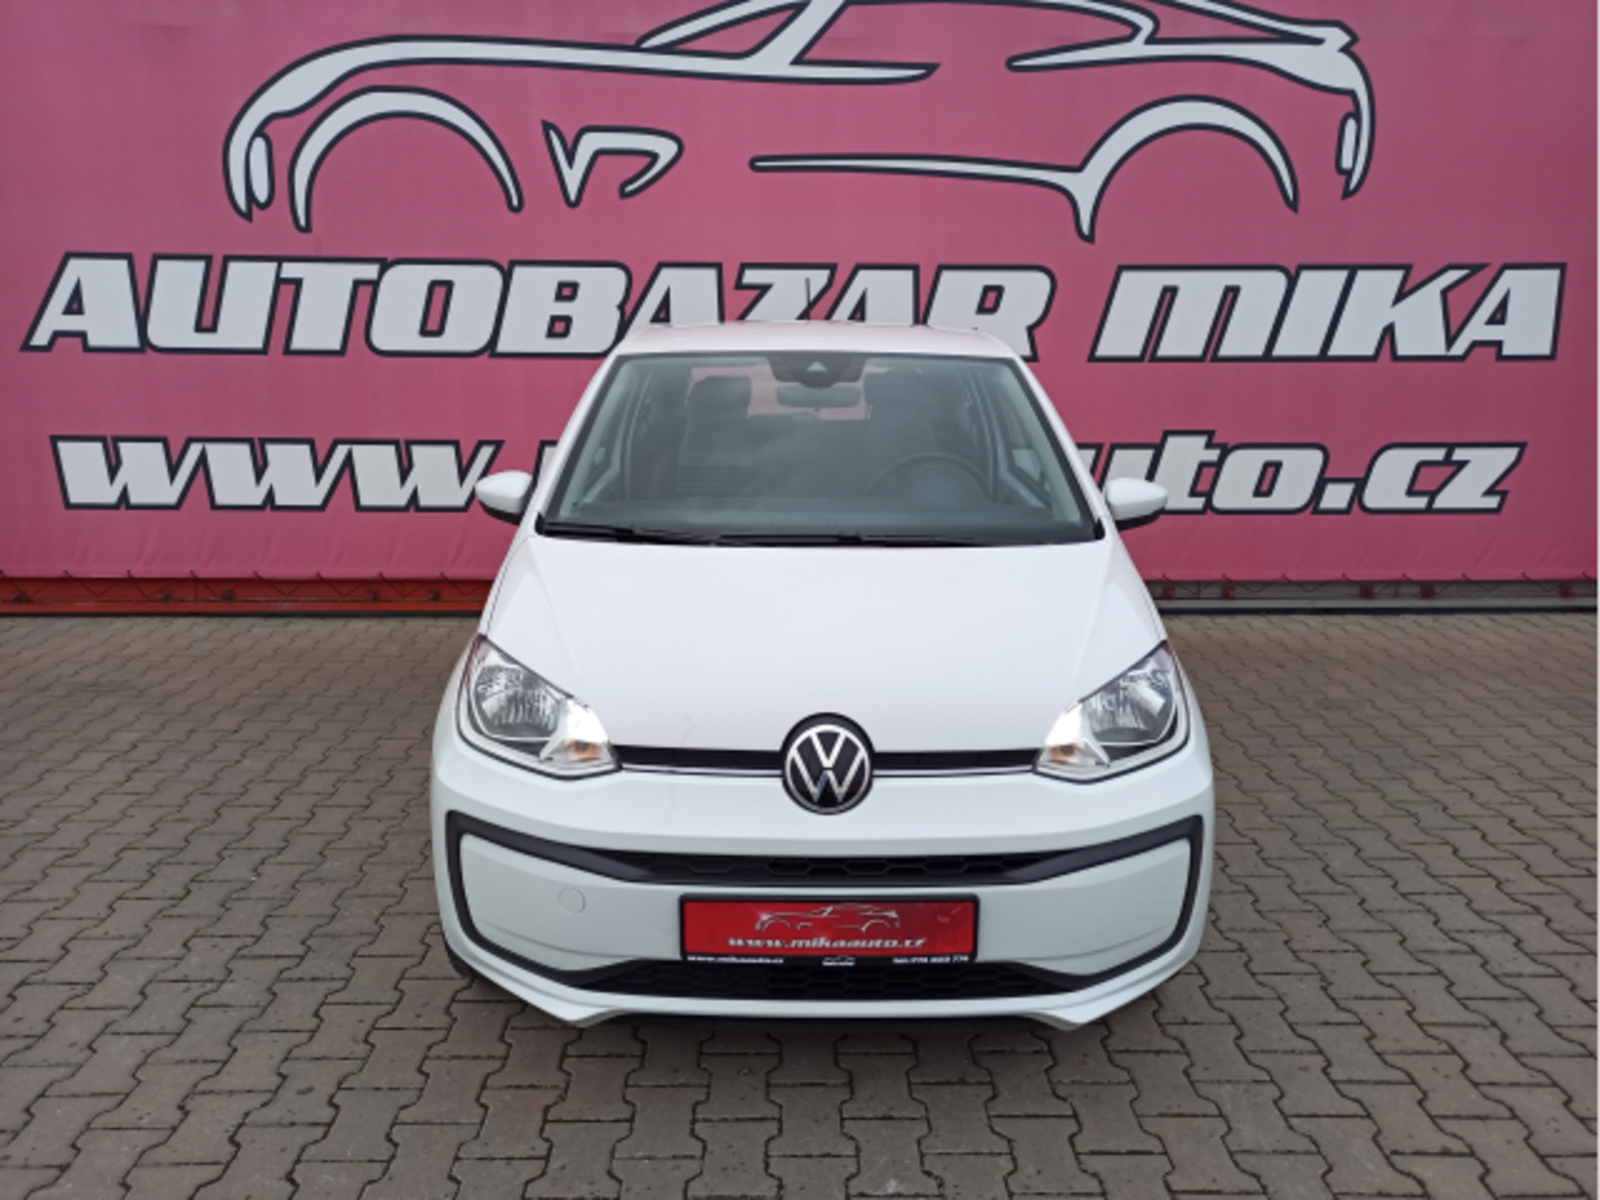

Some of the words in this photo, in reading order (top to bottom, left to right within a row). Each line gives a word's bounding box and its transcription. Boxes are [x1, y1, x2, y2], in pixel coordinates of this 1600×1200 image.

[20, 252, 1057, 361] AUTOBAZAR
[1087, 263, 1567, 363] MIKA
[728, 936, 926, 949] www.mikaauto.cz
